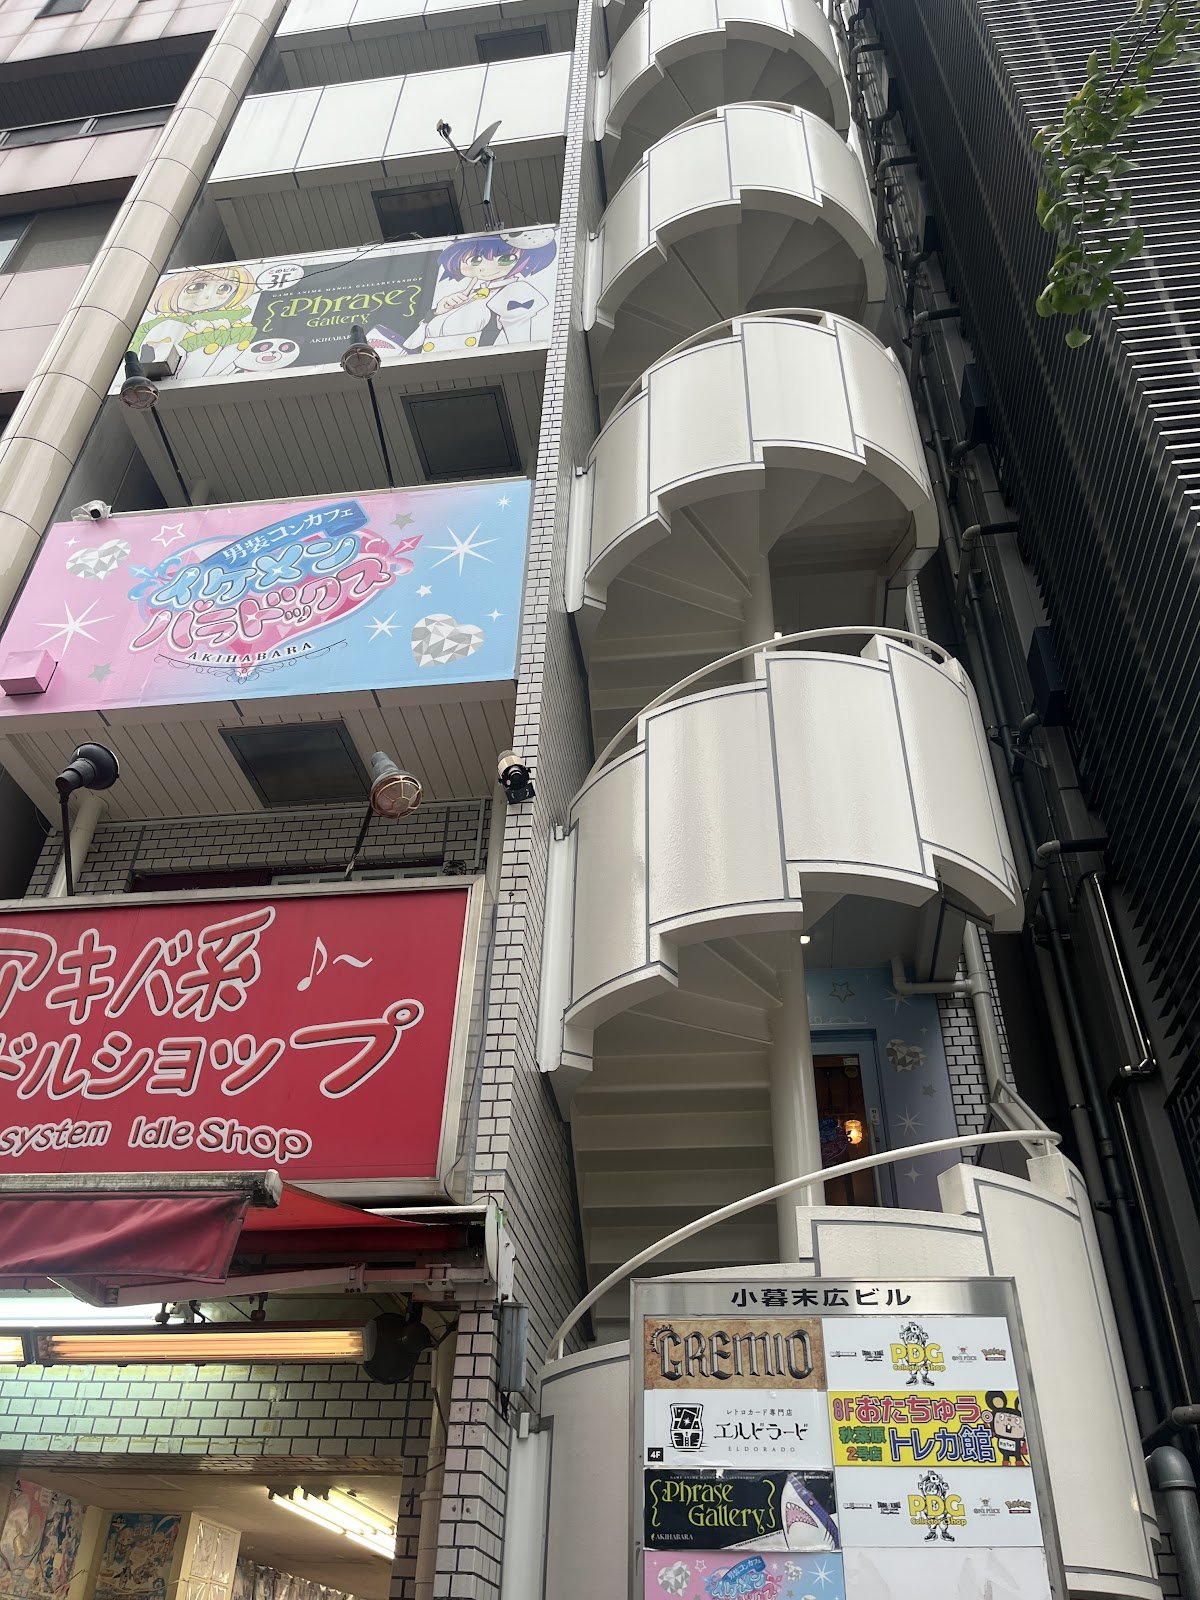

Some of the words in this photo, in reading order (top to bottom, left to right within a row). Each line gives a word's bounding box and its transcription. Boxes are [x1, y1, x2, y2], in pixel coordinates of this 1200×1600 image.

[267, 273, 292, 289] 3F
[268, 267, 299, 275] このビル
[281, 289, 406, 319] Phrase
[306, 313, 371, 328] Gallery
[310, 334, 352, 344] AKIHABAR
[222, 508, 354, 565] 男装コンカフェ
[152, 535, 358, 608] イケメン
[129, 556, 393, 650] パラドックス
[188, 642, 313, 664] AKIHABARA
[128, 1115, 194, 1149] Idle
[197, 1116, 313, 1164] Shop
[730, 1287, 912, 1308] 小暮末広ビル
[655, 1327, 815, 1382] GREMIO
[889, 1343, 945, 1364] PDG
[726, 1408, 793, 1417] レトロカード専門店
[832, 1398, 854, 1421] 8F
[713, 1422, 809, 1441] エルドラード
[838, 1426, 886, 1444] 秋葉原
[846, 1446, 883, 1462] 2号店
[888, 1424, 996, 1463] トレカ館
[649, 1450, 662, 1459] 4F
[661, 1480, 734, 1506] Phrase
[907, 1494, 966, 1517] PDG
[688, 1505, 766, 1534] Gallery
[656, 1533, 694, 1541] AKIHABARA
